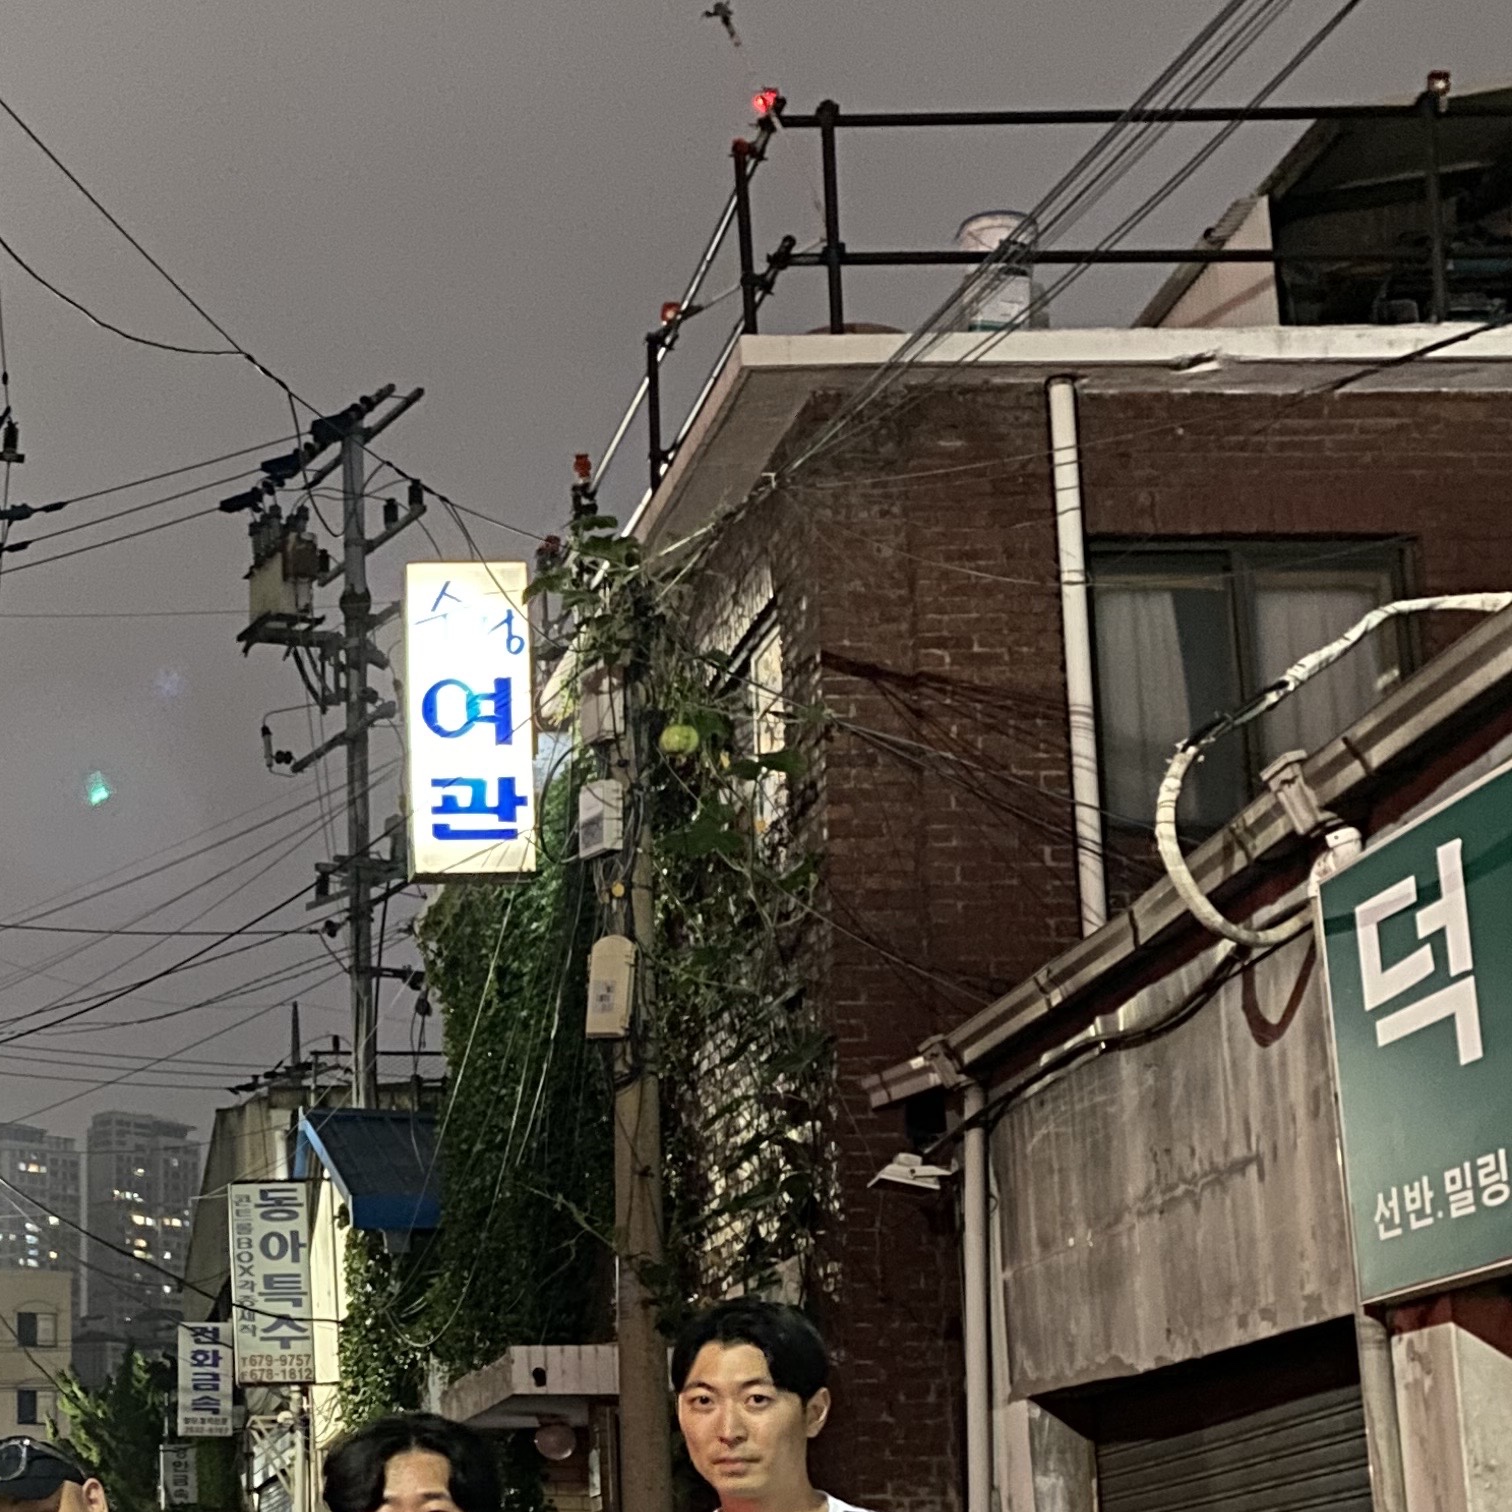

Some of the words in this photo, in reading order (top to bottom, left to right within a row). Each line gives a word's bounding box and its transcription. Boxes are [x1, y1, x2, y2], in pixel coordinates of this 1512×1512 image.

[422, 677, 528, 841] 여관
[1355, 838, 1483, 1066] 덕
[254, 1188, 310, 1349] 동아특수
